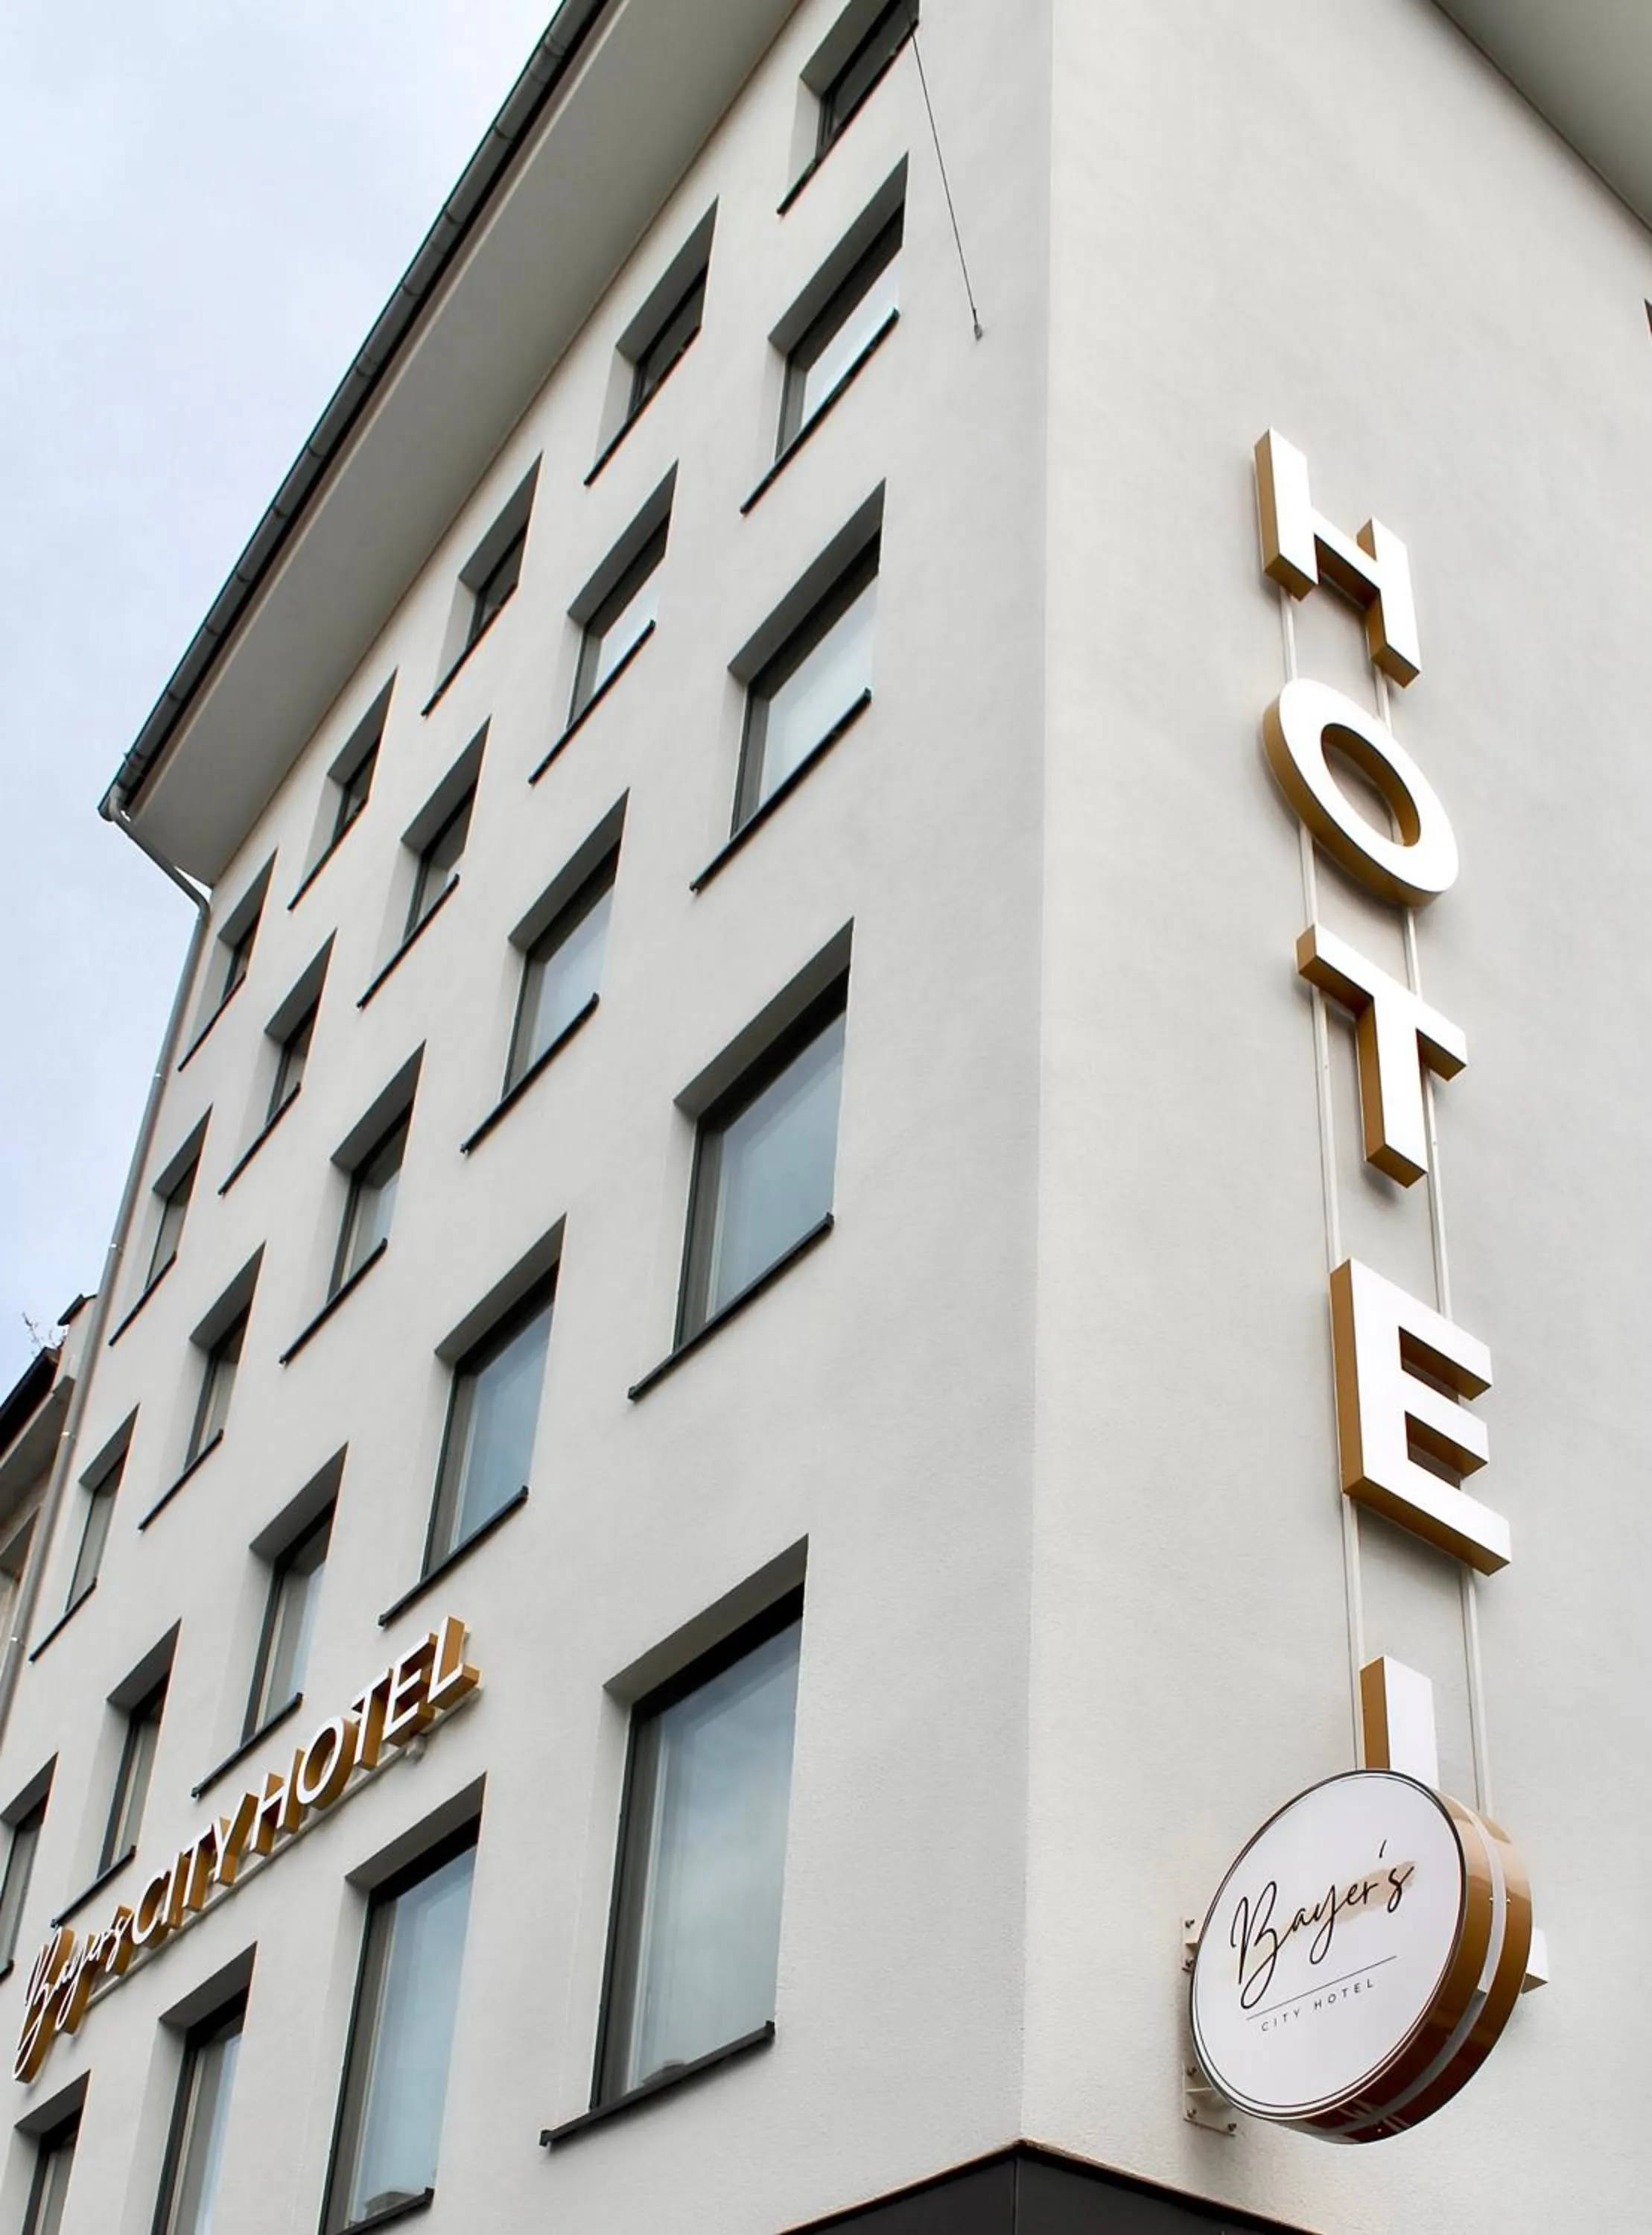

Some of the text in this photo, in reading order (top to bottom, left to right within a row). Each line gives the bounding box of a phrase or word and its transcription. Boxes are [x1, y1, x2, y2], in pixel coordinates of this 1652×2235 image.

[132, 1792, 259, 1949] CITY
[250, 1616, 480, 1856] HOTEL
[1230, 1839, 1414, 2009] Bayer's
[1261, 1978, 1374, 2032] CITY HOTEL
